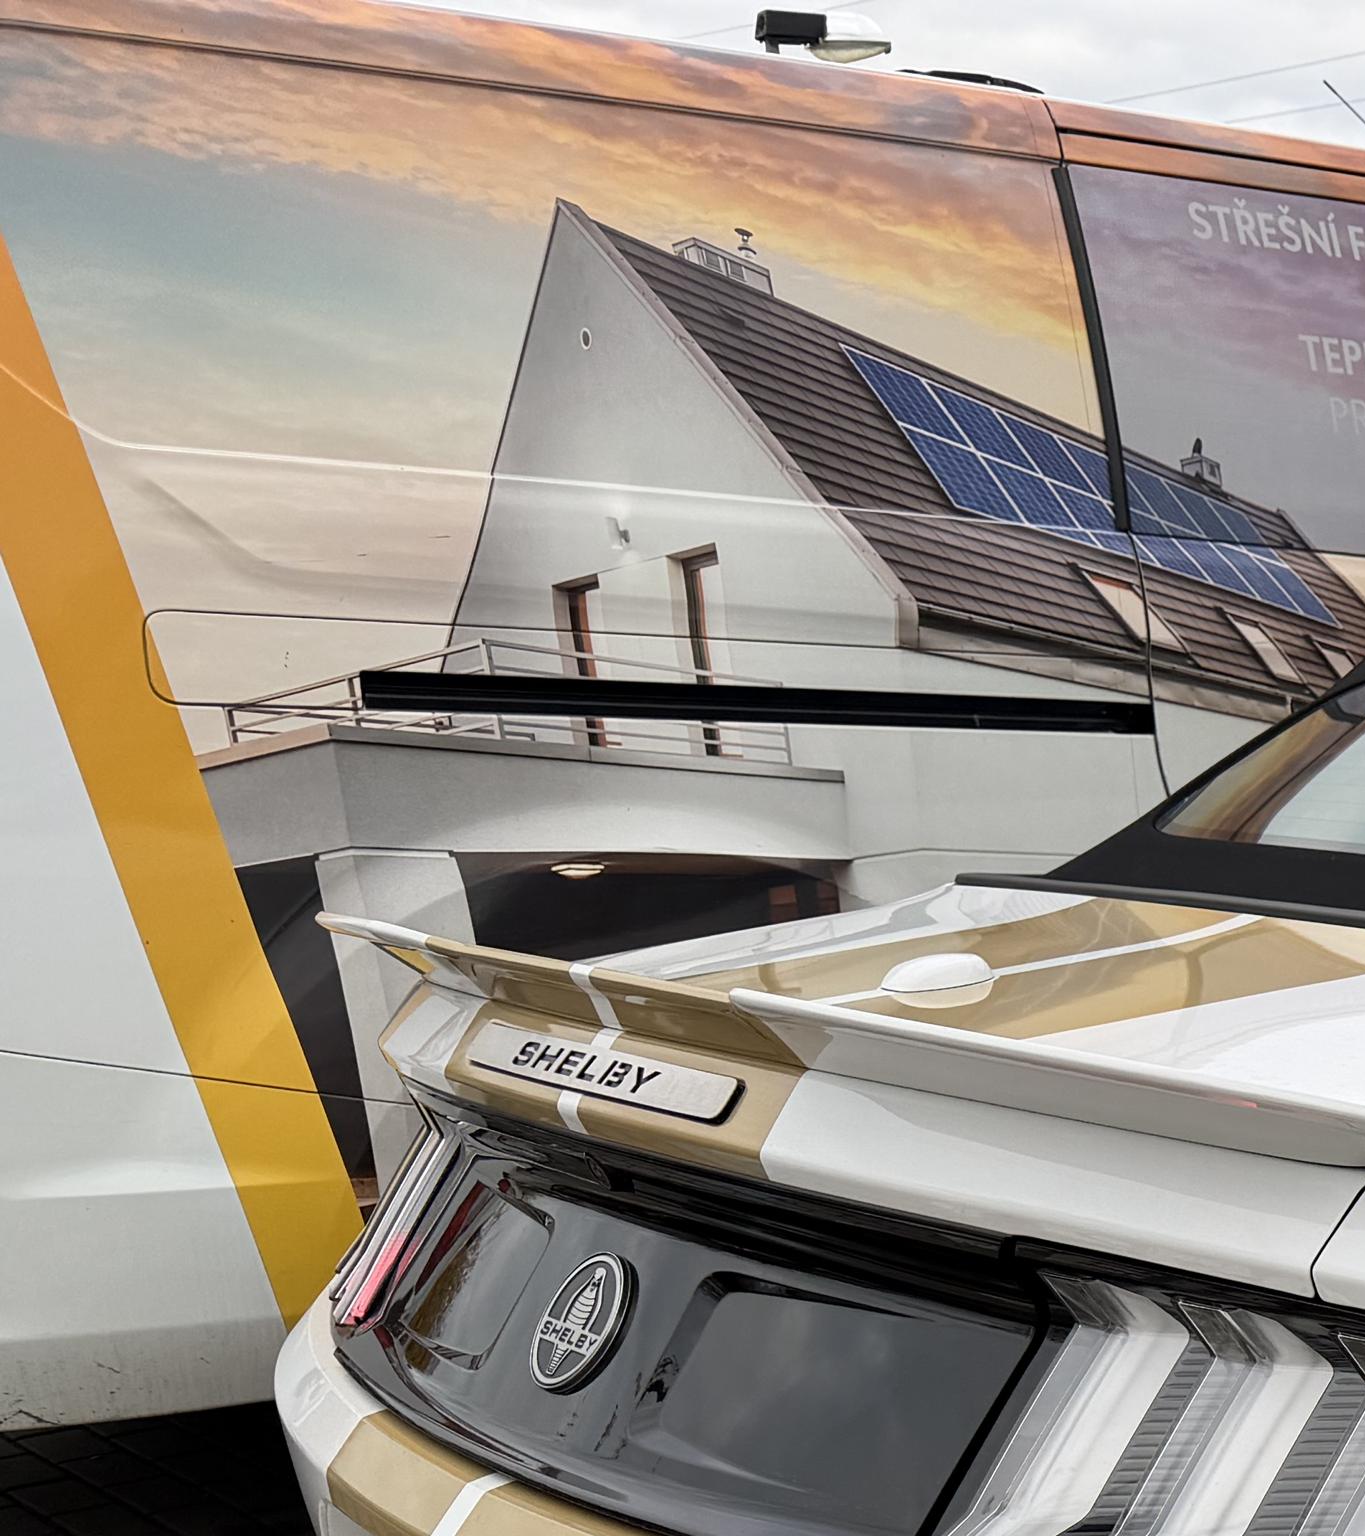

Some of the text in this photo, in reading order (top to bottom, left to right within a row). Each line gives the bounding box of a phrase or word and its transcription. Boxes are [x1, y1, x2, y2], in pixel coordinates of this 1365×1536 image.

[1187, 196, 1343, 258] STŘEŠNÍ
[510, 1039, 663, 1096] SHELBY
[540, 1319, 599, 1353] SHELBY
